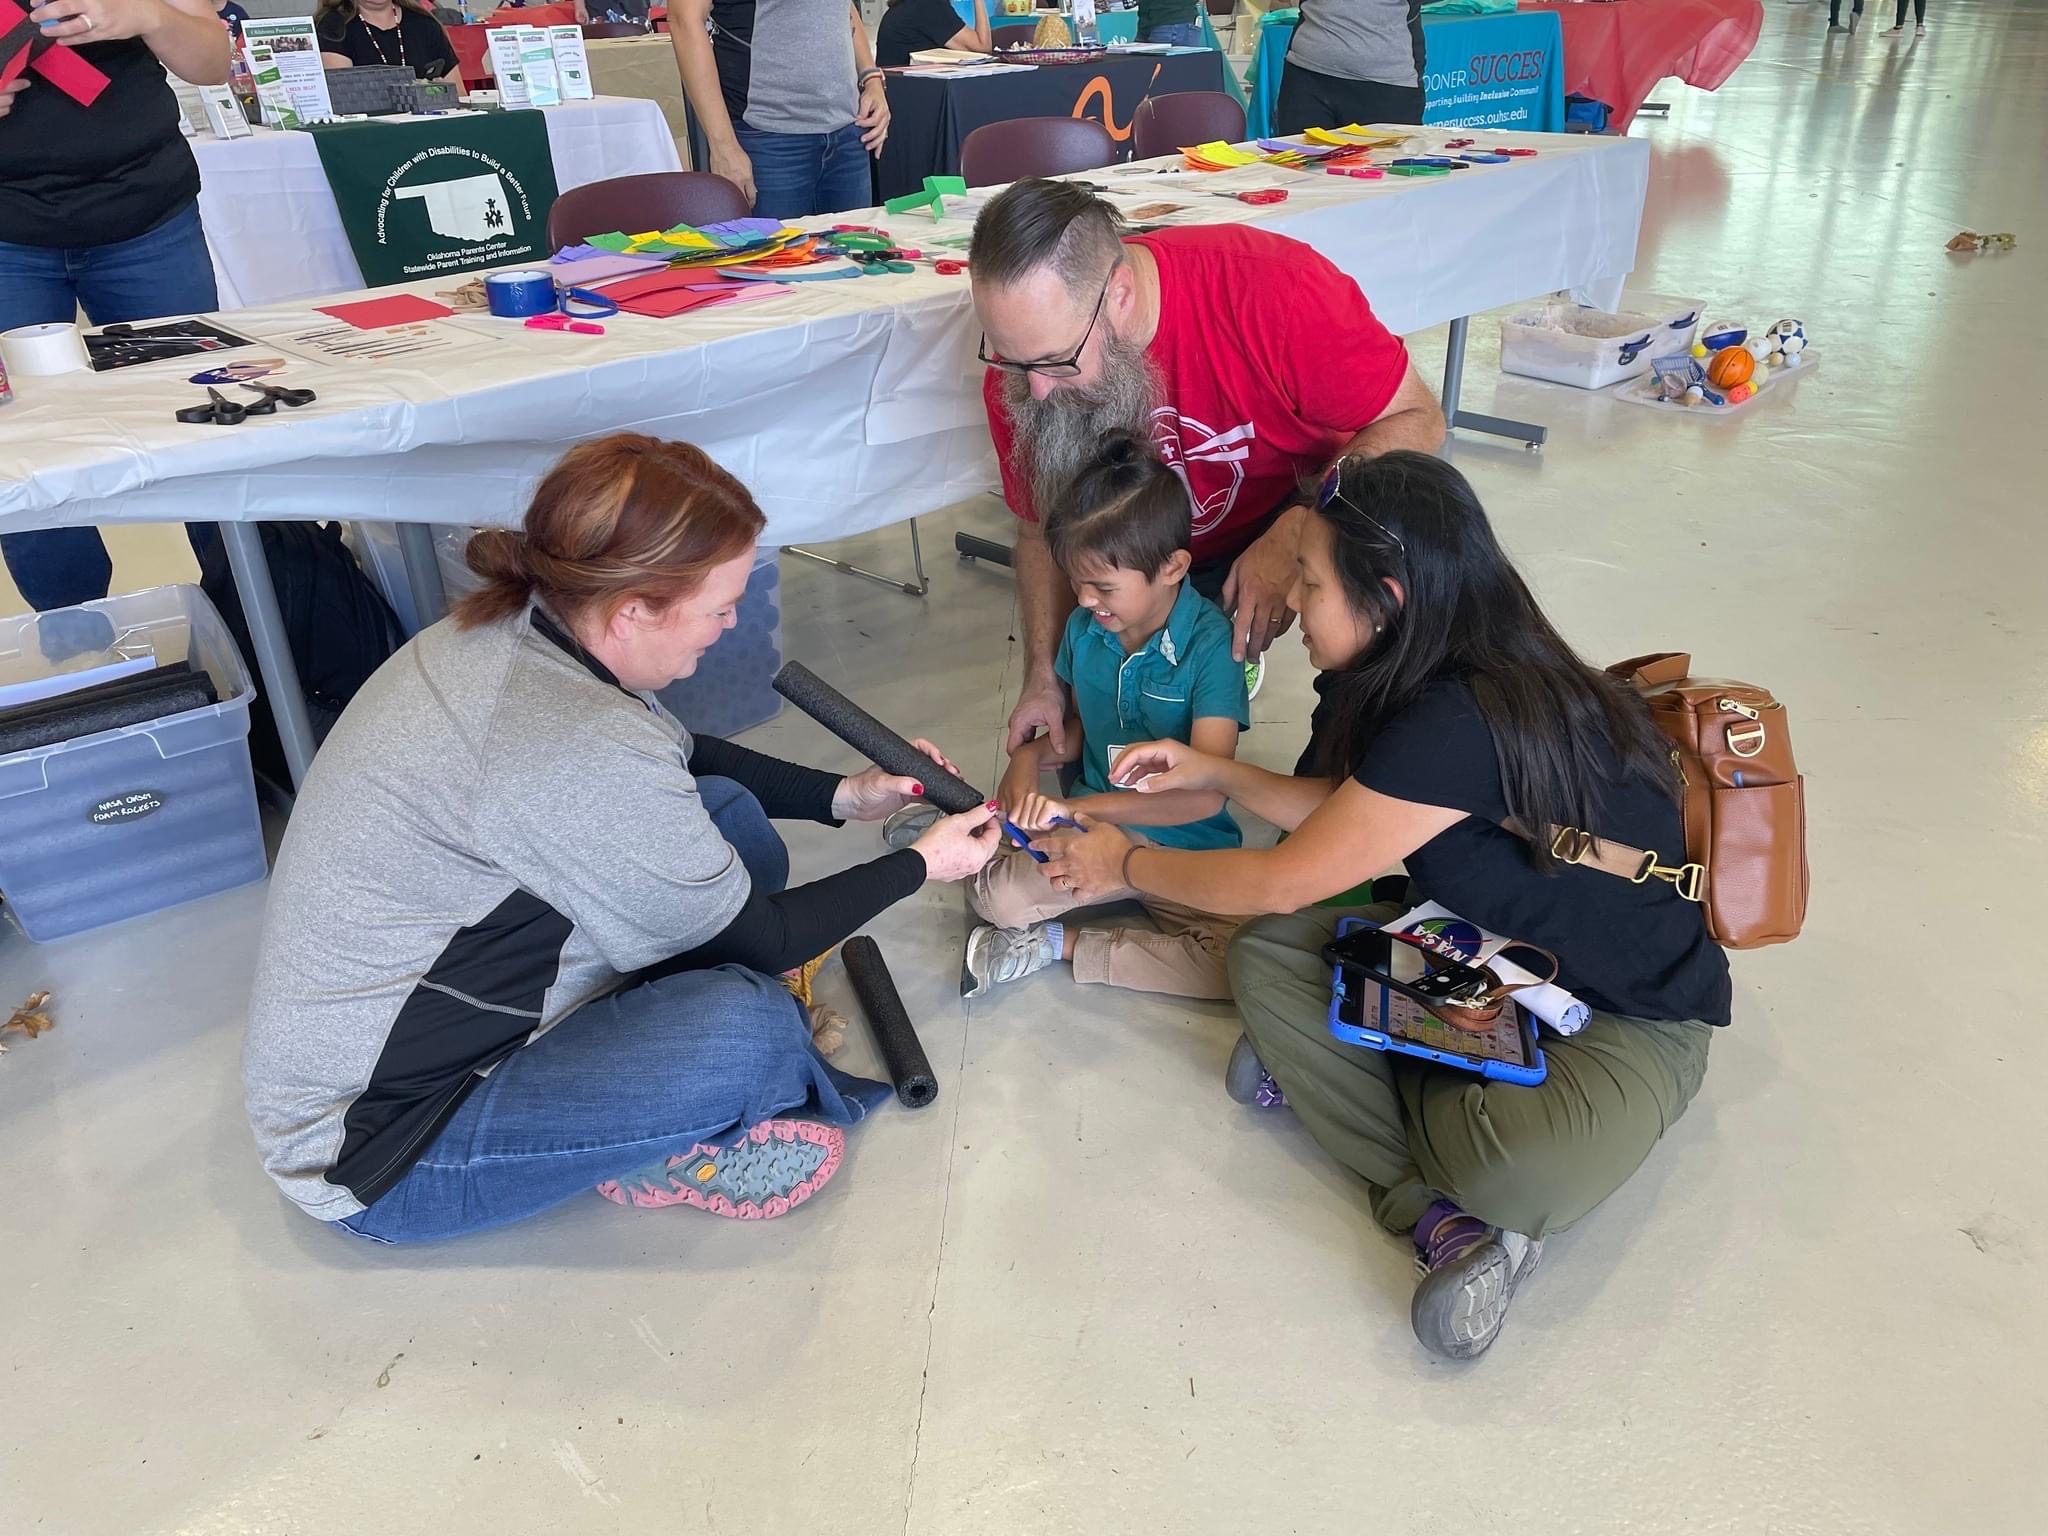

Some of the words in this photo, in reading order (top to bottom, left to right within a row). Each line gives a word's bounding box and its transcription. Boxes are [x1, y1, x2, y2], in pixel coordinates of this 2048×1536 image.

[1423, 70, 1467, 93] OONER
[1469, 50, 1546, 86] SUCCES
[412, 151, 429, 164] with
[428, 145, 471, 157] Disabilities
[472, 149, 480, 159] to
[480, 153, 501, 170] Build
[387, 160, 413, 187] Children
[505, 171, 524, 195] Better
[382, 186, 392, 199] for
[520, 195, 532, 220] Future
[377, 197, 389, 245] Advocating
[403, 262, 436, 274] Statewide
[437, 258, 459, 268] Parent
[460, 255, 485, 266] Training
[485, 251, 497, 260] and
[498, 245, 532, 258] Information
[426, 249, 461, 262] Oklahoma
[461, 245, 485, 256] Parents
[485, 241, 508, 251] Center
[93, 810, 120, 822] FOAM
[120, 800, 161, 815] ROCKETS
[98, 799, 123, 811] NASA
[1412, 923, 1468, 961] NASA
